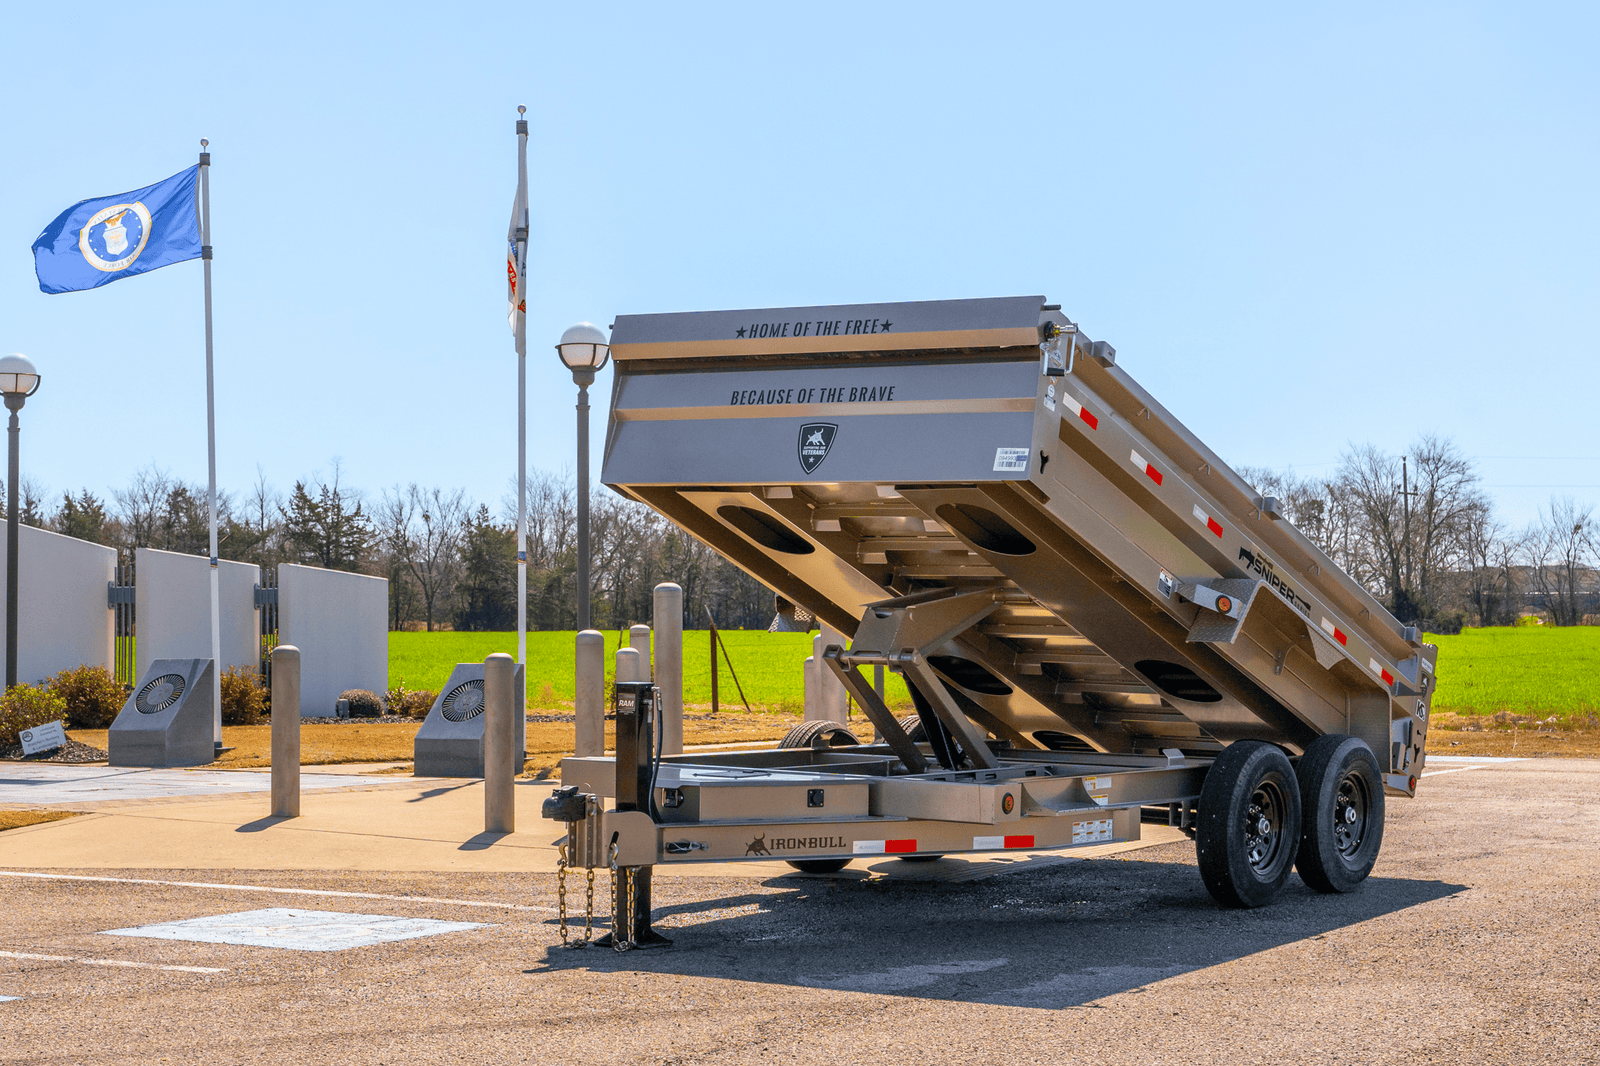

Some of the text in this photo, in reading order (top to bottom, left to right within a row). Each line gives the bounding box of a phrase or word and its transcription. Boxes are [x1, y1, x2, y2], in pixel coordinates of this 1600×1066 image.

[749, 319, 880, 339] HOME OF THE FREE
[730, 386, 896, 406] BECAUSE OF THE BRAVE
[1253, 558, 1295, 605] SNIPER
[618, 699, 635, 707] RAM
[770, 836, 846, 850] IRONBULL
